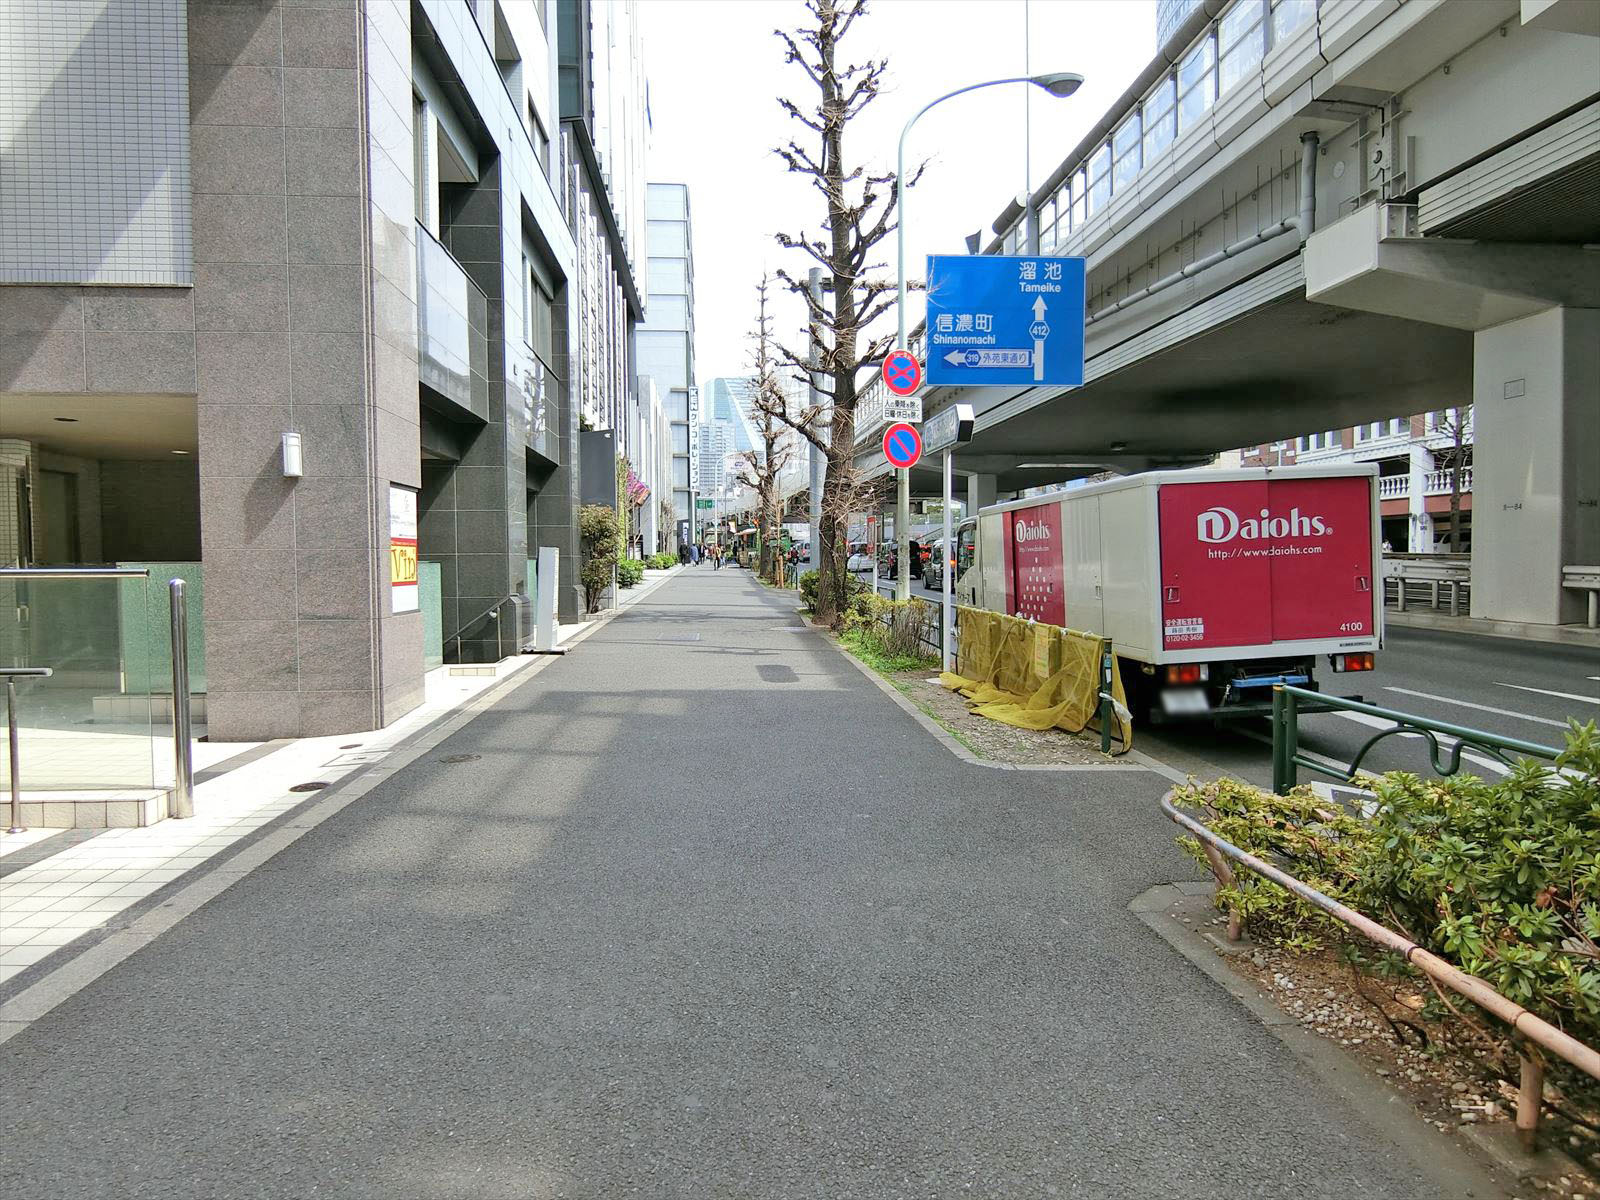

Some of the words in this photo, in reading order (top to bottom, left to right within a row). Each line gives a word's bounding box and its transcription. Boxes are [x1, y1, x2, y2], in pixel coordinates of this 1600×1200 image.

[1019, 261, 1062, 281] 溜池
[1019, 282, 1061, 293] Tameike
[936, 313, 993, 332] 信濃町
[1032, 325, 1048, 336] 412
[933, 334, 996, 345] Shinanomachi
[967, 353, 980, 362] 319
[983, 352, 1027, 364] 外苑東通り
[1016, 519, 1050, 543] Daiohs
[1340, 622, 1363, 631] 4100
